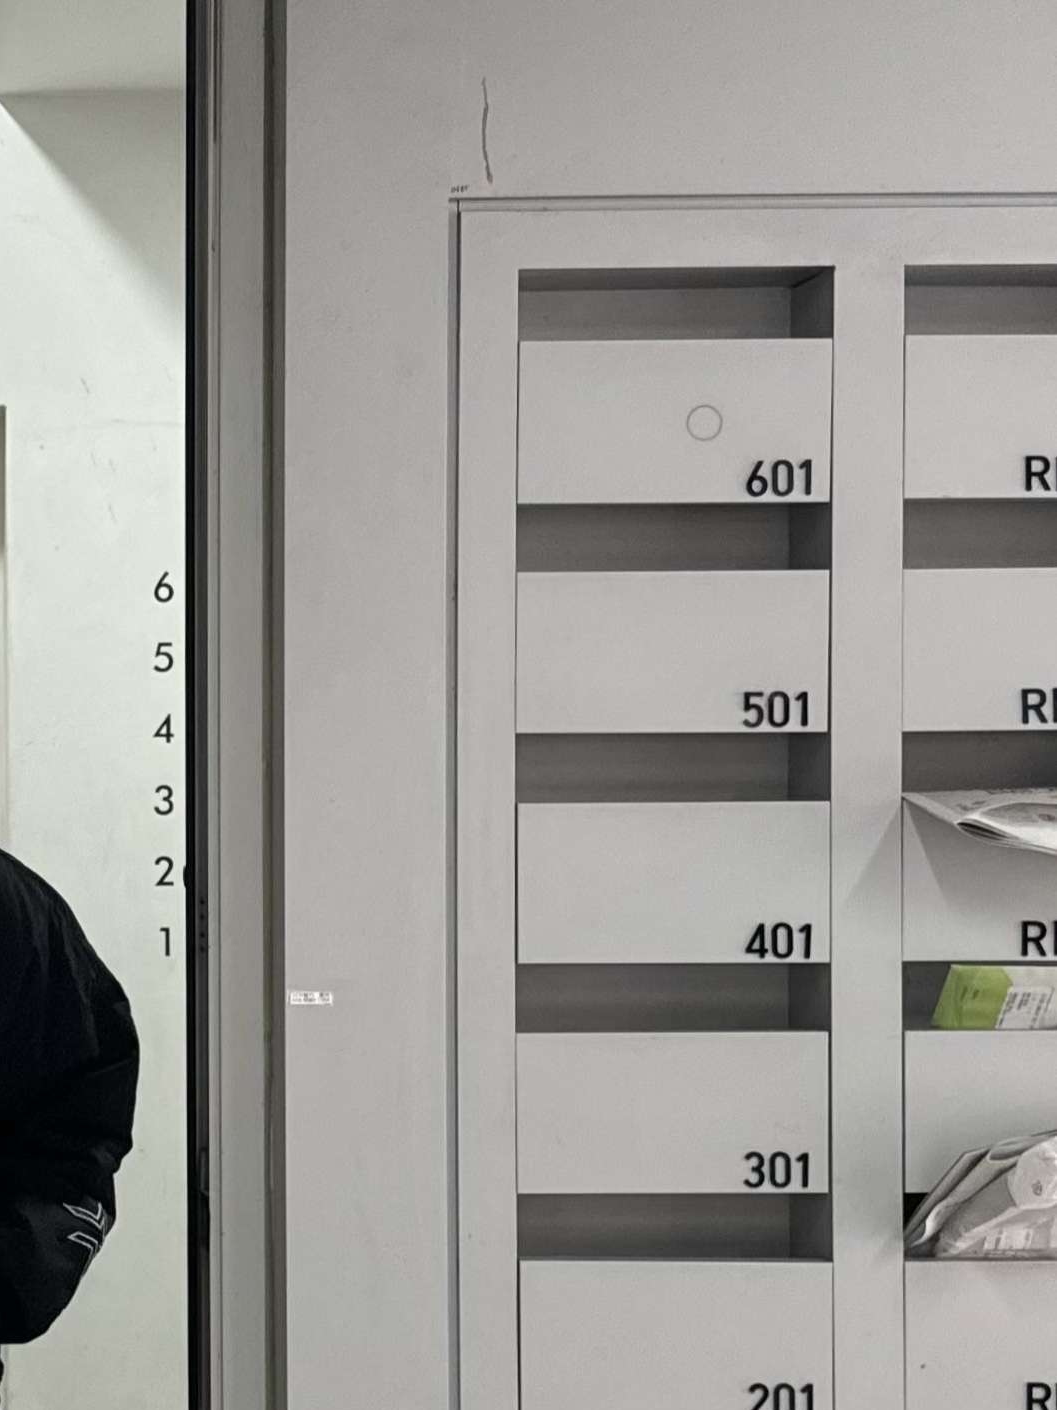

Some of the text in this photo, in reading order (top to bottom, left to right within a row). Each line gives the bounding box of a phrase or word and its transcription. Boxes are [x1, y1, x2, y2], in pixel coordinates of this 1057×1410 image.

[745, 459, 812, 496] 601
[1024, 455, 1057, 491] R
[153, 571, 174, 603] 6
[153, 642, 174, 673] 5
[743, 691, 809, 728] 501
[153, 714, 175, 744] 4
[153, 784, 174, 816] 3
[154, 856, 175, 887] 2
[159, 927, 171, 957] 1
[744, 922, 812, 960] 401
[1020, 920, 1057, 957] R
[743, 1151, 809, 1189] 301
